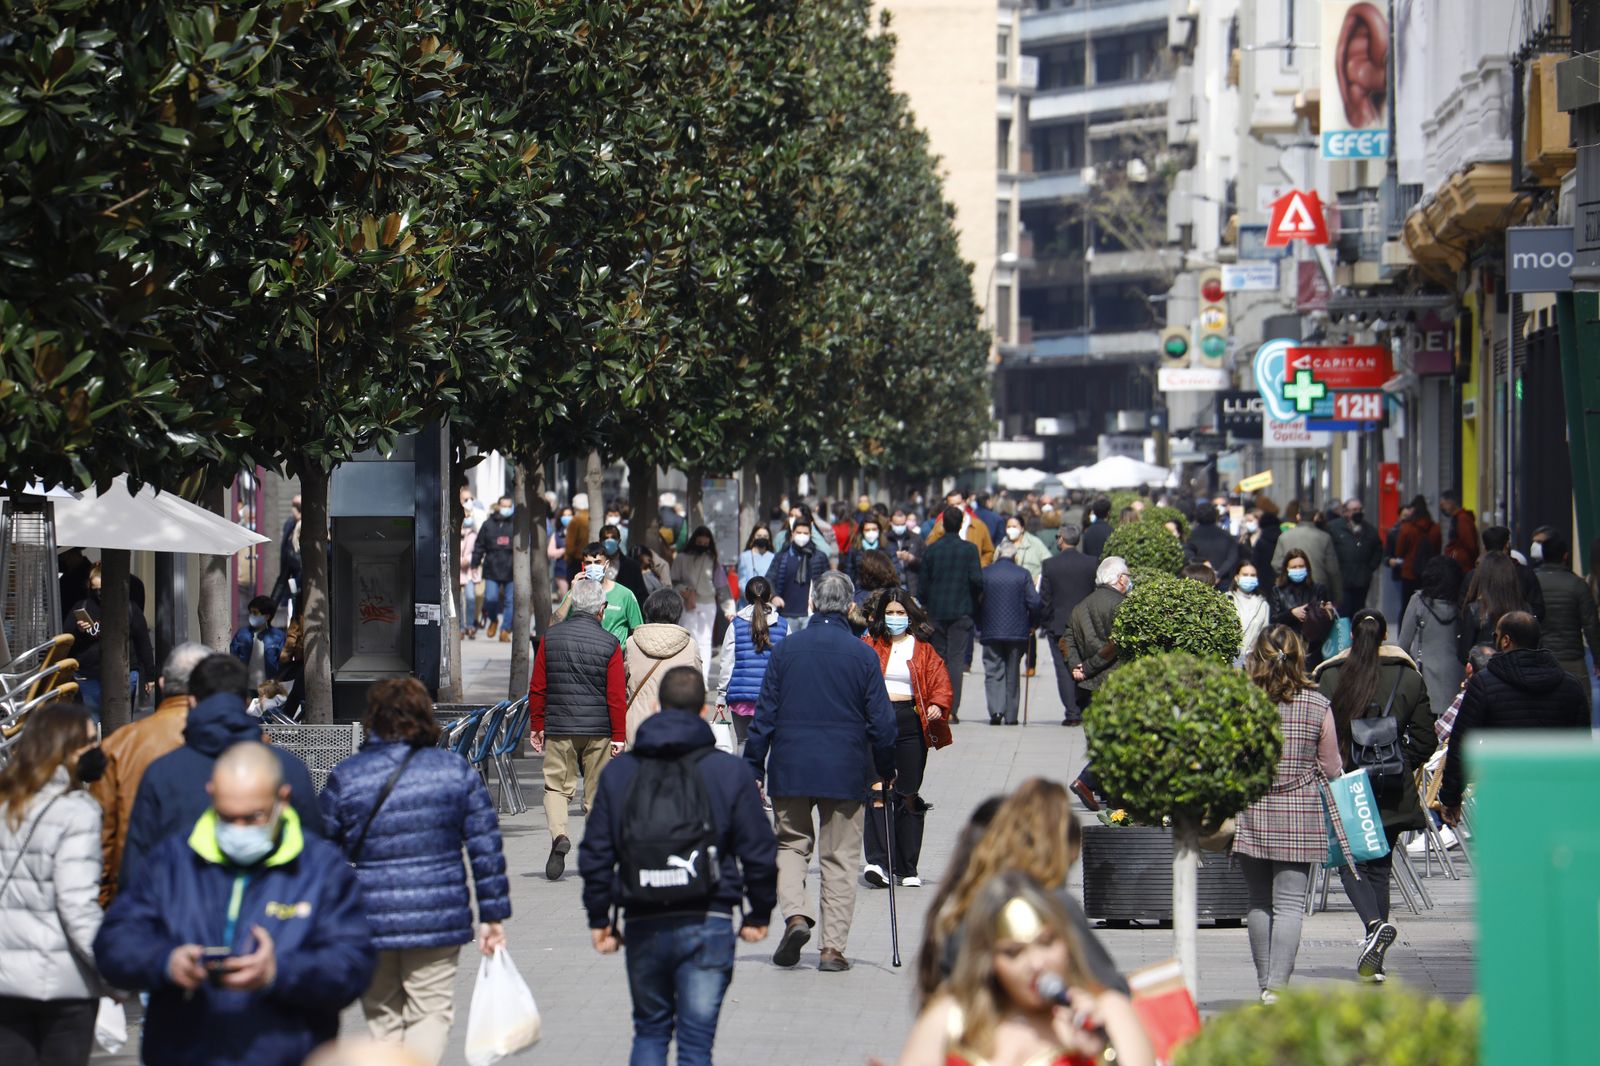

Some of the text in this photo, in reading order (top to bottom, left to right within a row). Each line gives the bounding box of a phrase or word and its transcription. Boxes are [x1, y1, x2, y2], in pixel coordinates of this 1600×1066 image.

[1513, 252, 1573, 269] moo
[1313, 358, 1376, 368] CAPITAN
[1337, 393, 1380, 419] 12H
[1349, 782, 1380, 852] moonë
[639, 868, 689, 888] PUMA
